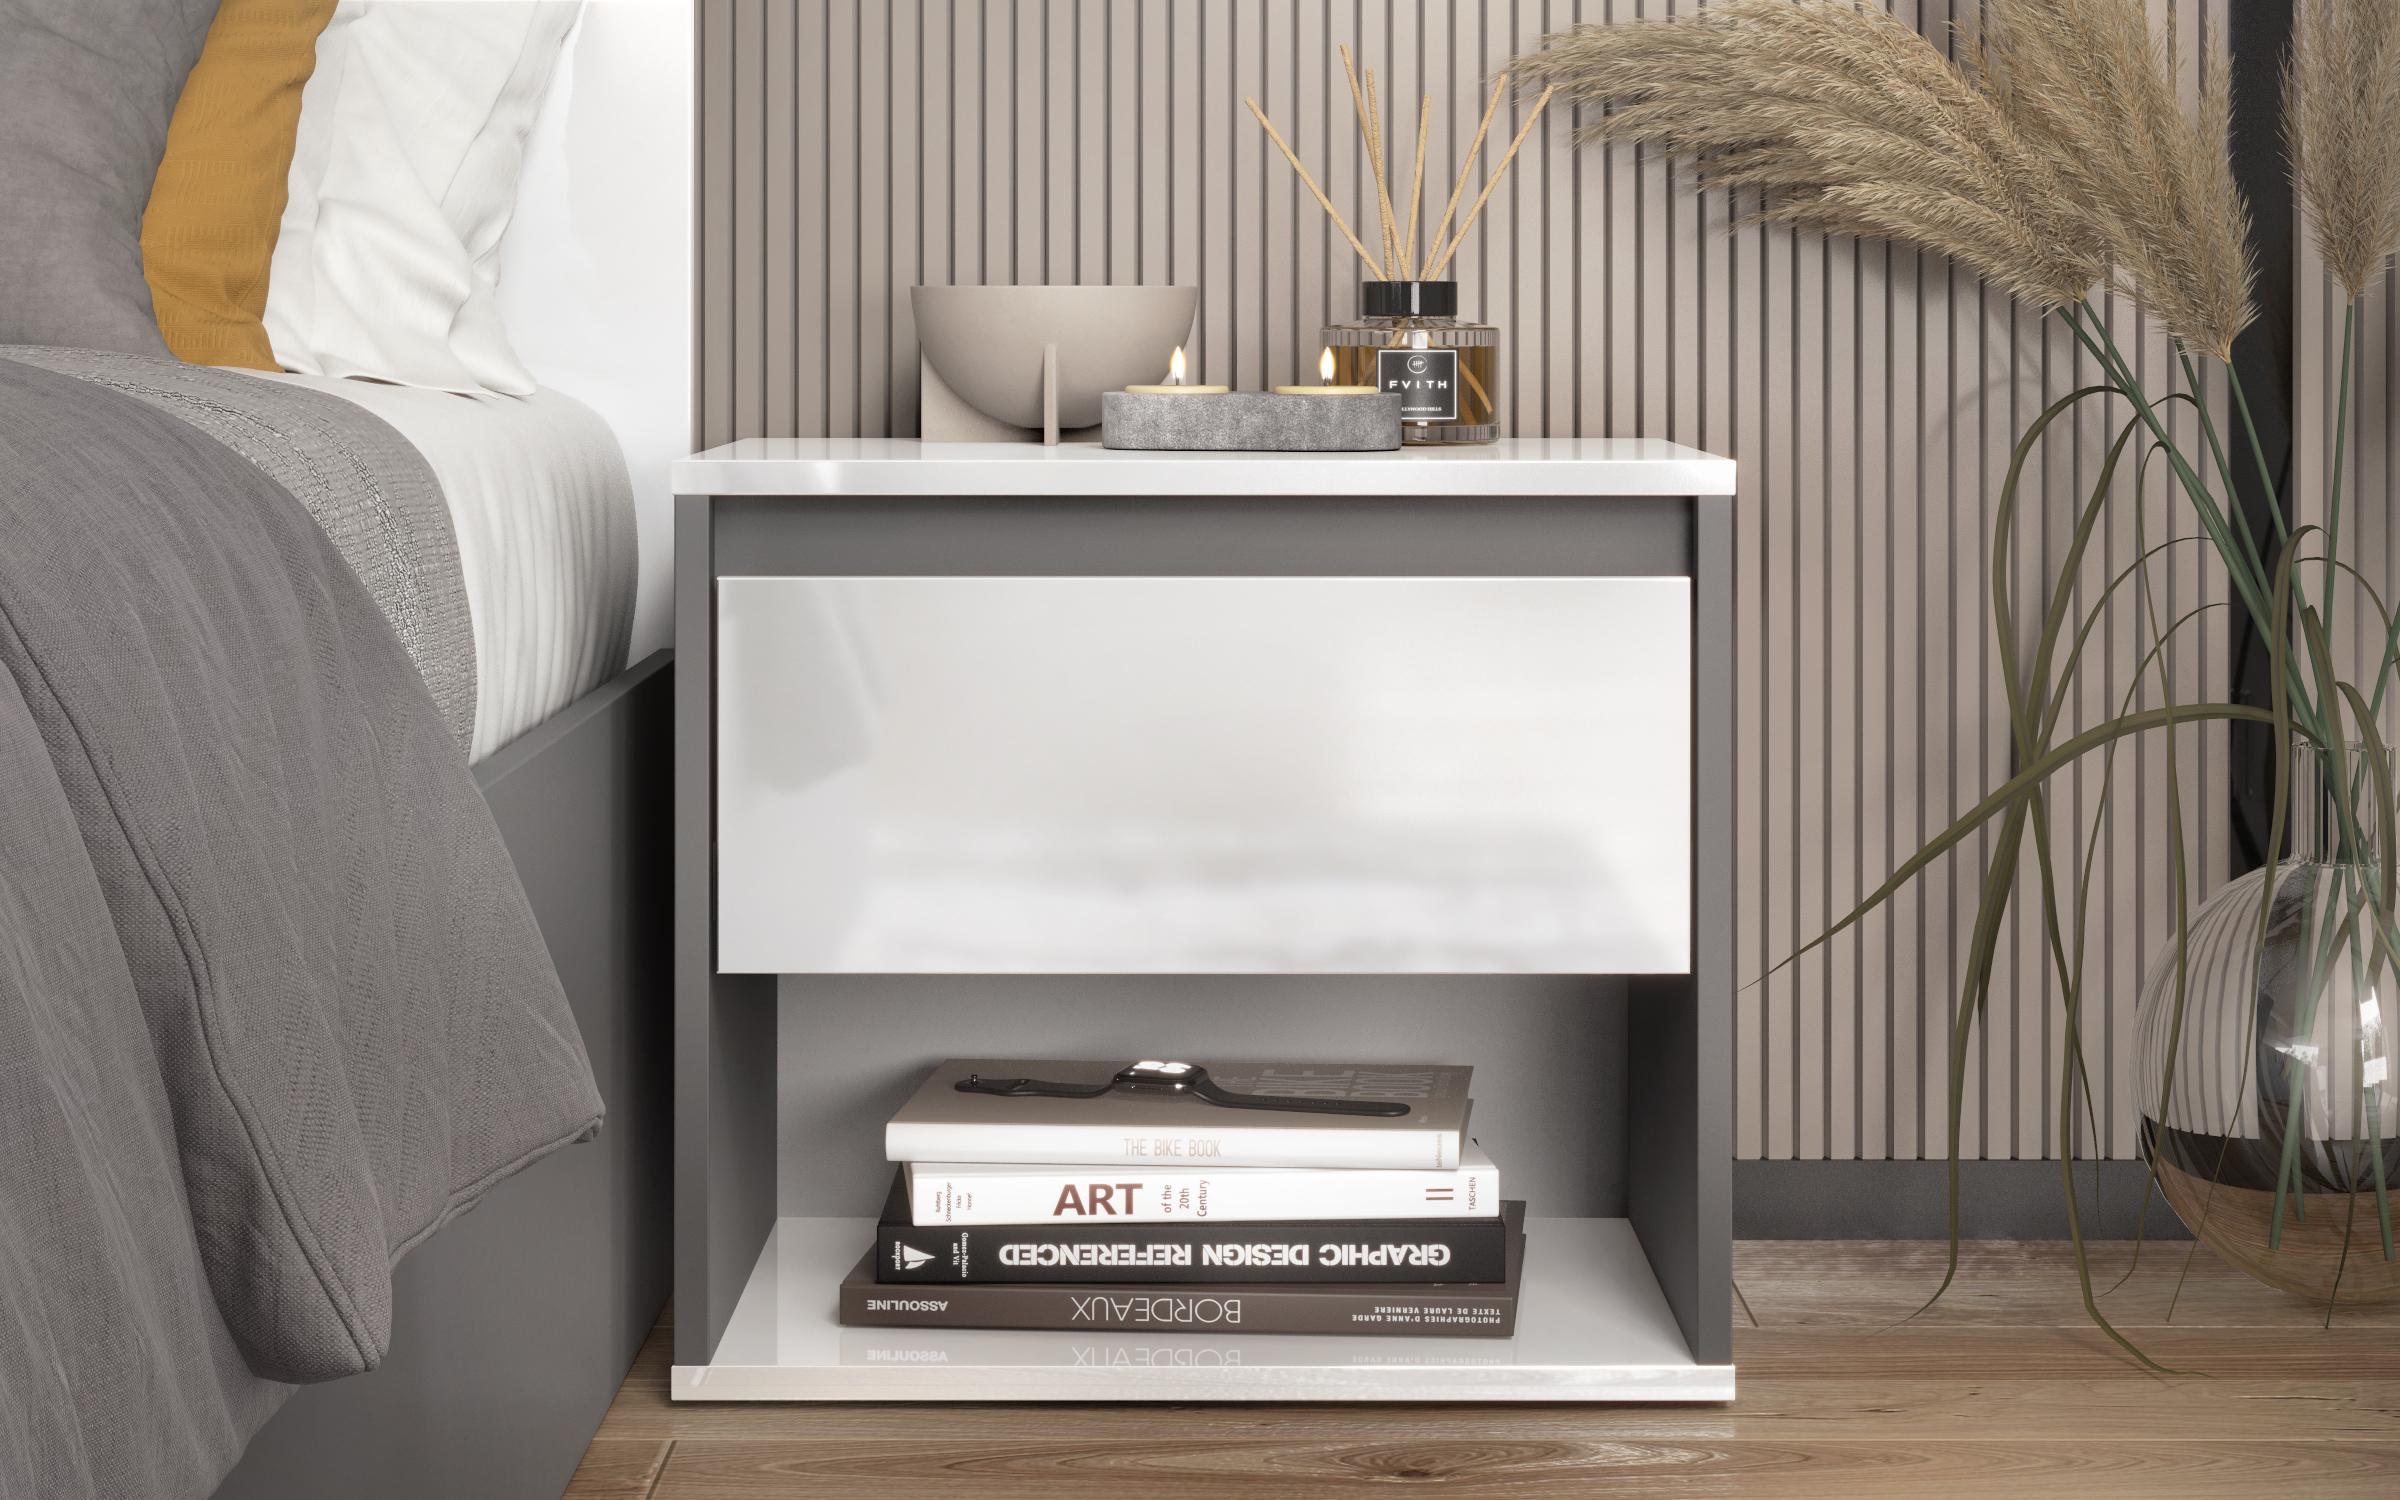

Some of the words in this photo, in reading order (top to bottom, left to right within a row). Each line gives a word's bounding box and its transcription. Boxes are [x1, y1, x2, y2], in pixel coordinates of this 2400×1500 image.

[1389, 380, 1448, 390] FVITH
[1124, 1138, 1148, 1157] THE
[1153, 1138, 1182, 1157] BIKE
[1188, 1139, 1222, 1158] BOOK
[1053, 1183, 1143, 1216] ART
[1161, 1184, 1172, 1200] the
[1179, 1187, 1190, 1209] 20th
[1196, 1179, 1210, 1217] Century
[1468, 1176, 1477, 1211] TASCHEN
[1161, 1202, 1172, 1213] of
[999, 1244, 1192, 1266] REFERENCED
[1202, 1244, 1310, 1266] DESIGN
[1319, 1244, 1451, 1266] GRAPHIC
[867, 1299, 948, 1311] ASSOULINE
[1071, 1297, 1241, 1323] BORDEAUX
[1424, 1307, 1452, 1315] LAURE
[1457, 1307, 1469, 1315] DE
[1473, 1307, 1501, 1315] TEXTE
[1388, 1314, 1421, 1322] D'ANNE
[1424, 1315, 1501, 1323] PHOTOGRAPHIES
